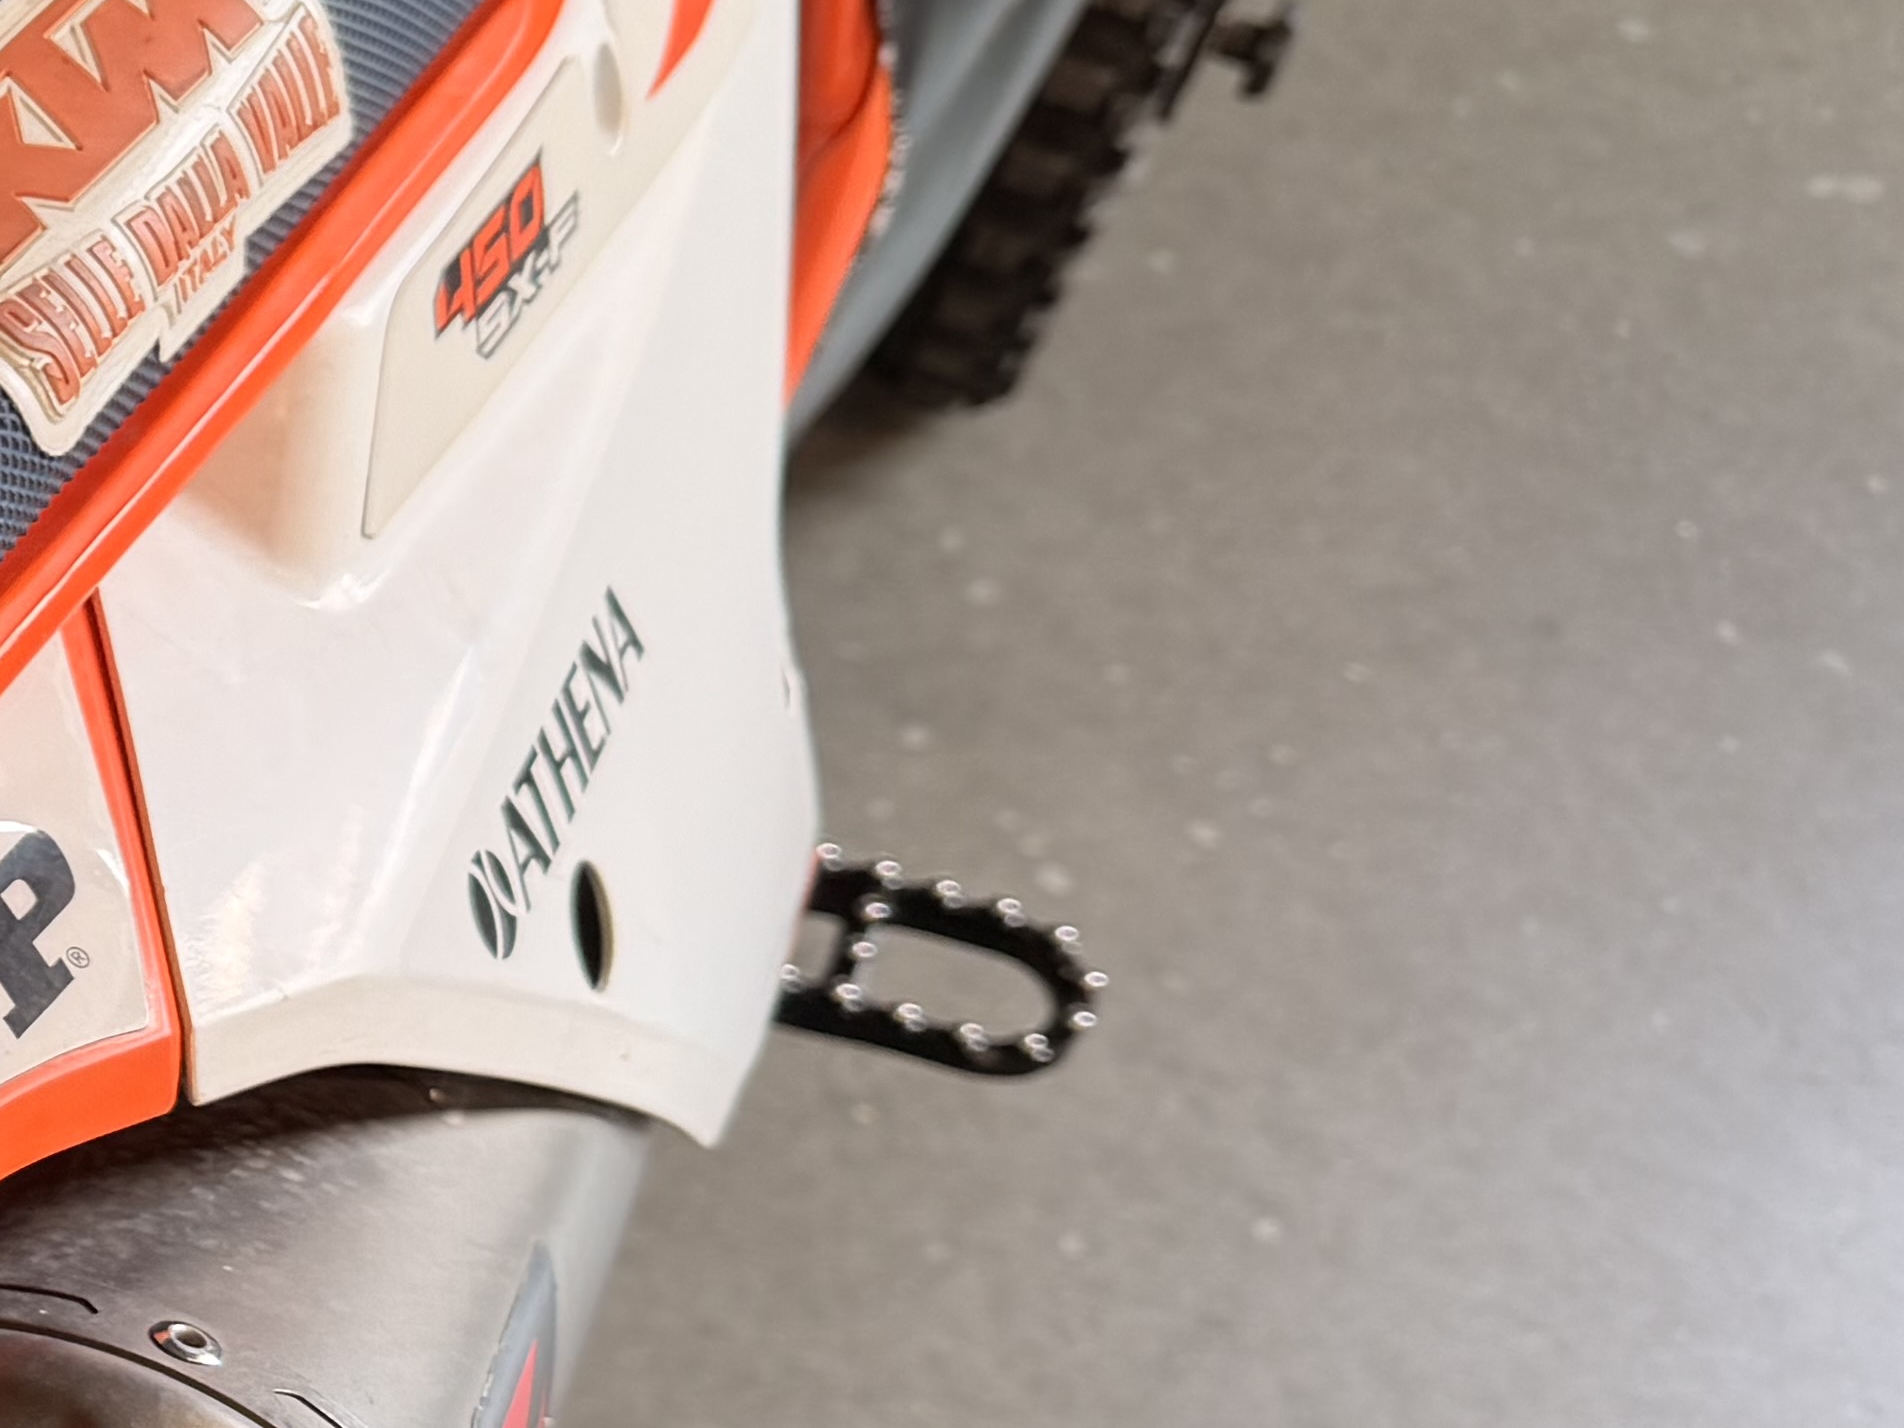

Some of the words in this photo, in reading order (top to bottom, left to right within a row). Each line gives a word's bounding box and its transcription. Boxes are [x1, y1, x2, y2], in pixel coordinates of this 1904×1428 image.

[126, 130, 251, 288] DALLA
[433, 152, 545, 338] 450
[500, 584, 644, 914] ATHENA
